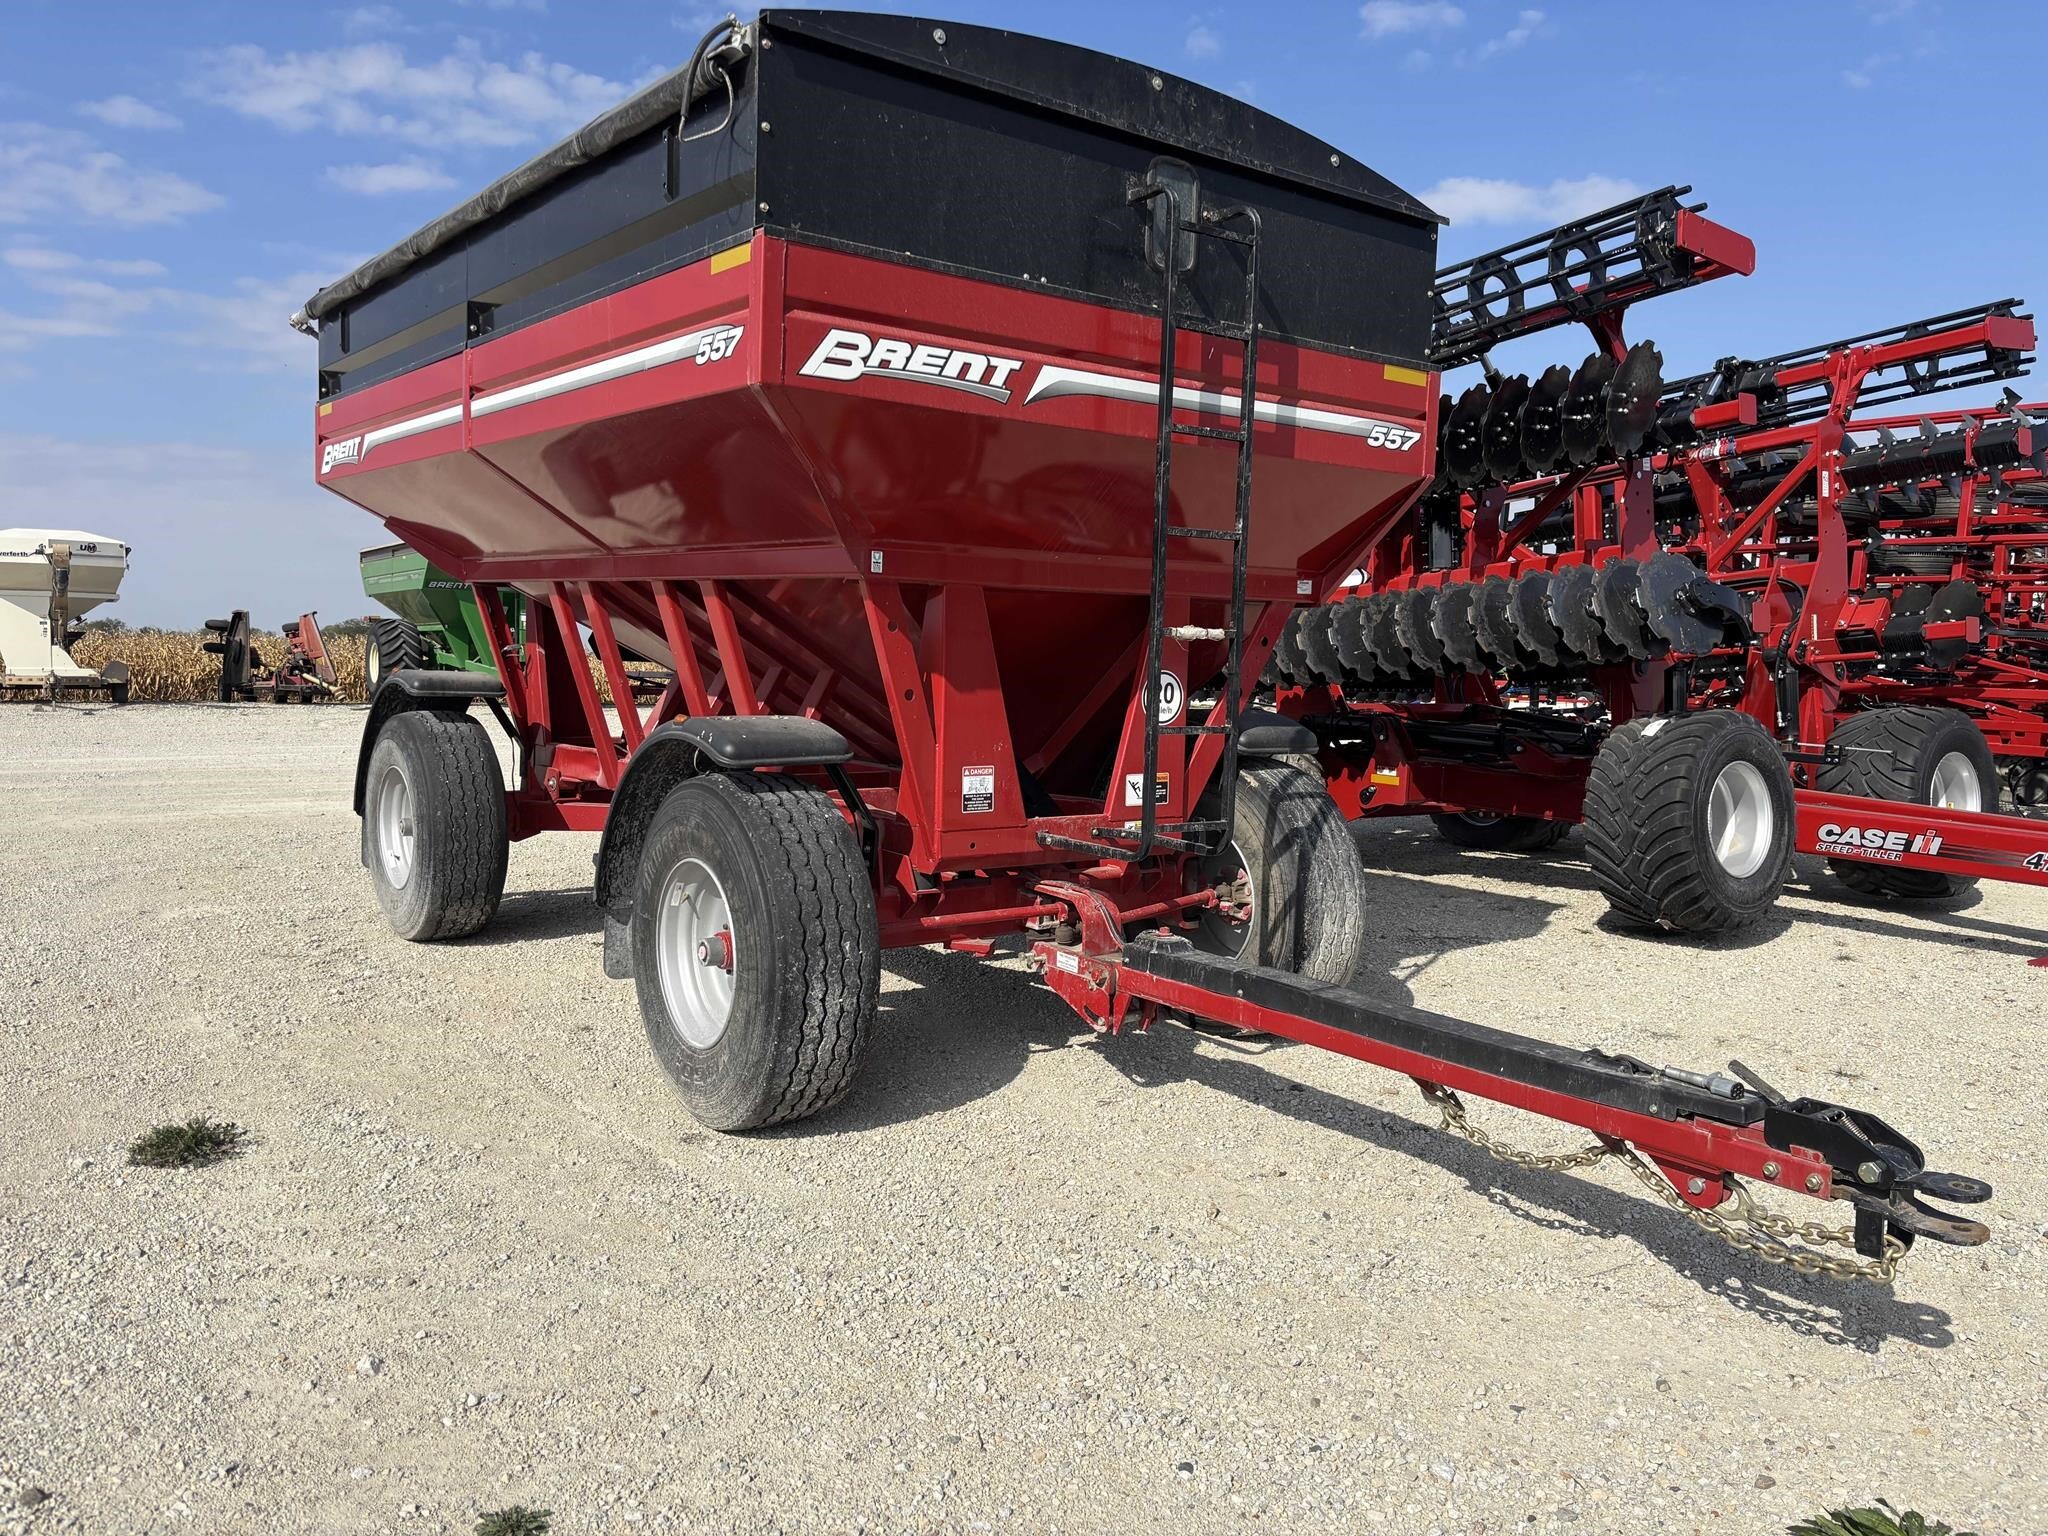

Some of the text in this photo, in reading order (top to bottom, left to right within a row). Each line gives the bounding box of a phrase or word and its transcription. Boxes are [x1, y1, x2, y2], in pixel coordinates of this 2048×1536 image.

[695, 325, 745, 365] 557
[799, 328, 1024, 390] BRENT
[1366, 425, 1422, 451] 557
[321, 436, 361, 474] BRENT
[428, 581, 472, 589] BRENT
[1817, 823, 1909, 851] CASE
[1816, 842, 1903, 861] SPEED-TILLER
